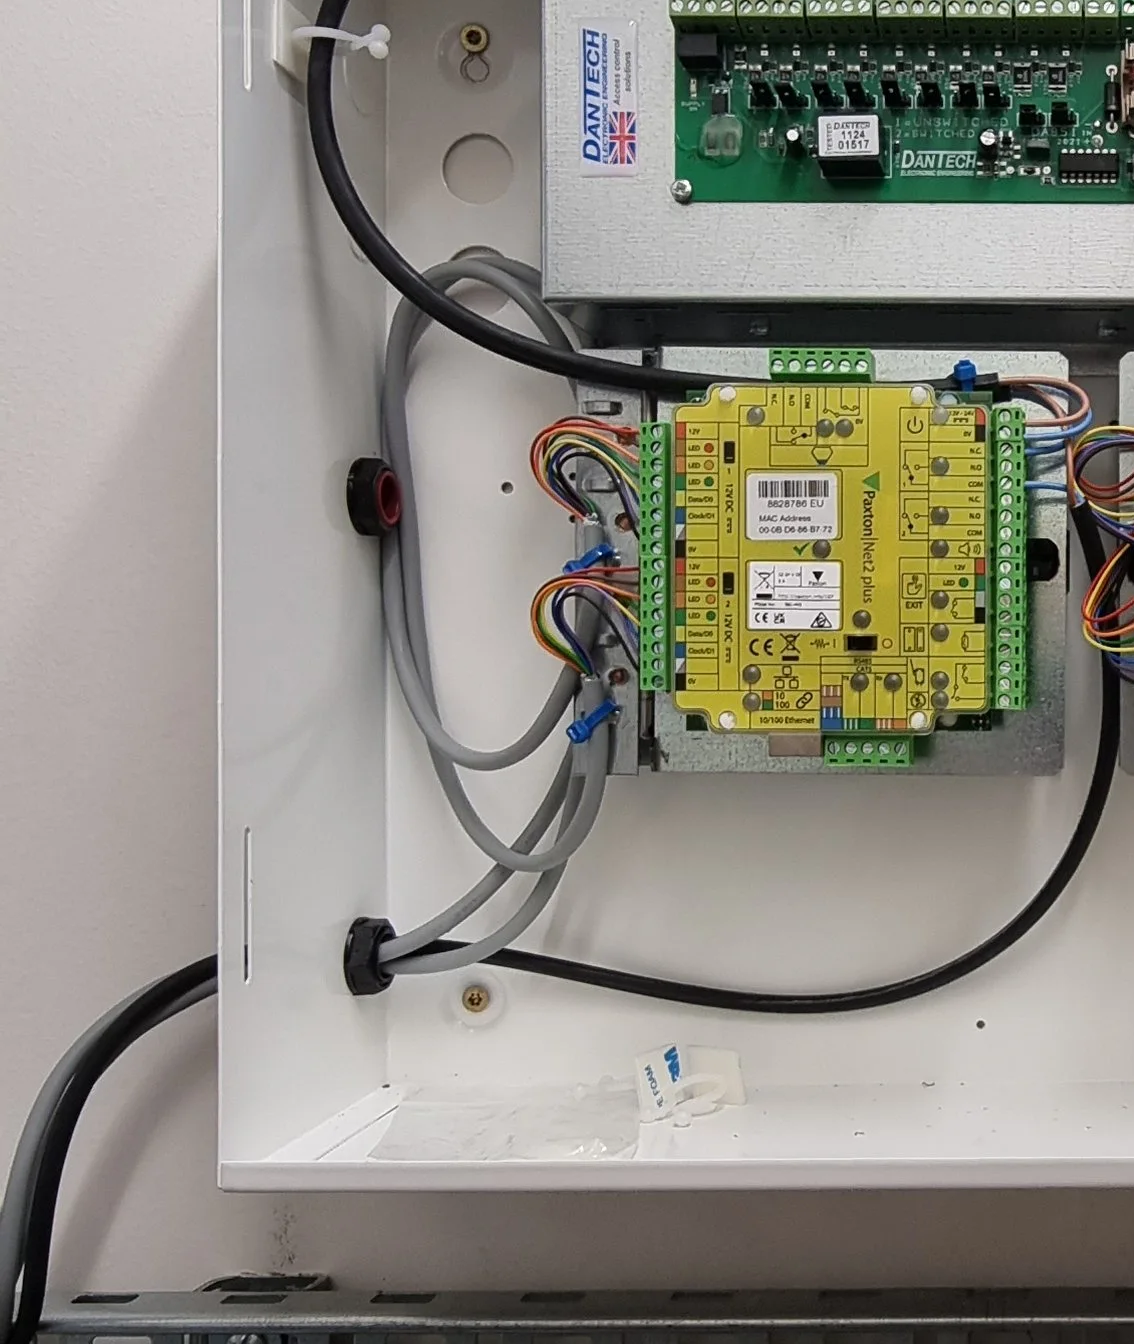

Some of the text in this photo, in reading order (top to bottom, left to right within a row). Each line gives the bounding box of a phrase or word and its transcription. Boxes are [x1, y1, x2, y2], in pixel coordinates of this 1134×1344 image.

[601, 103, 609, 164] ELECTRONIC
[841, 131, 865, 140] 1124
[838, 140, 870, 150] 01517
[725, 500, 733, 513] DC
[810, 499, 824, 507] EU
[862, 576, 875, 604] plus
[724, 614, 732, 630] 12V
[724, 630, 732, 643] DC
[749, 638, 774, 656] CE
[776, 701, 790, 709] 100
[645, 1064, 660, 1096] FOAM
